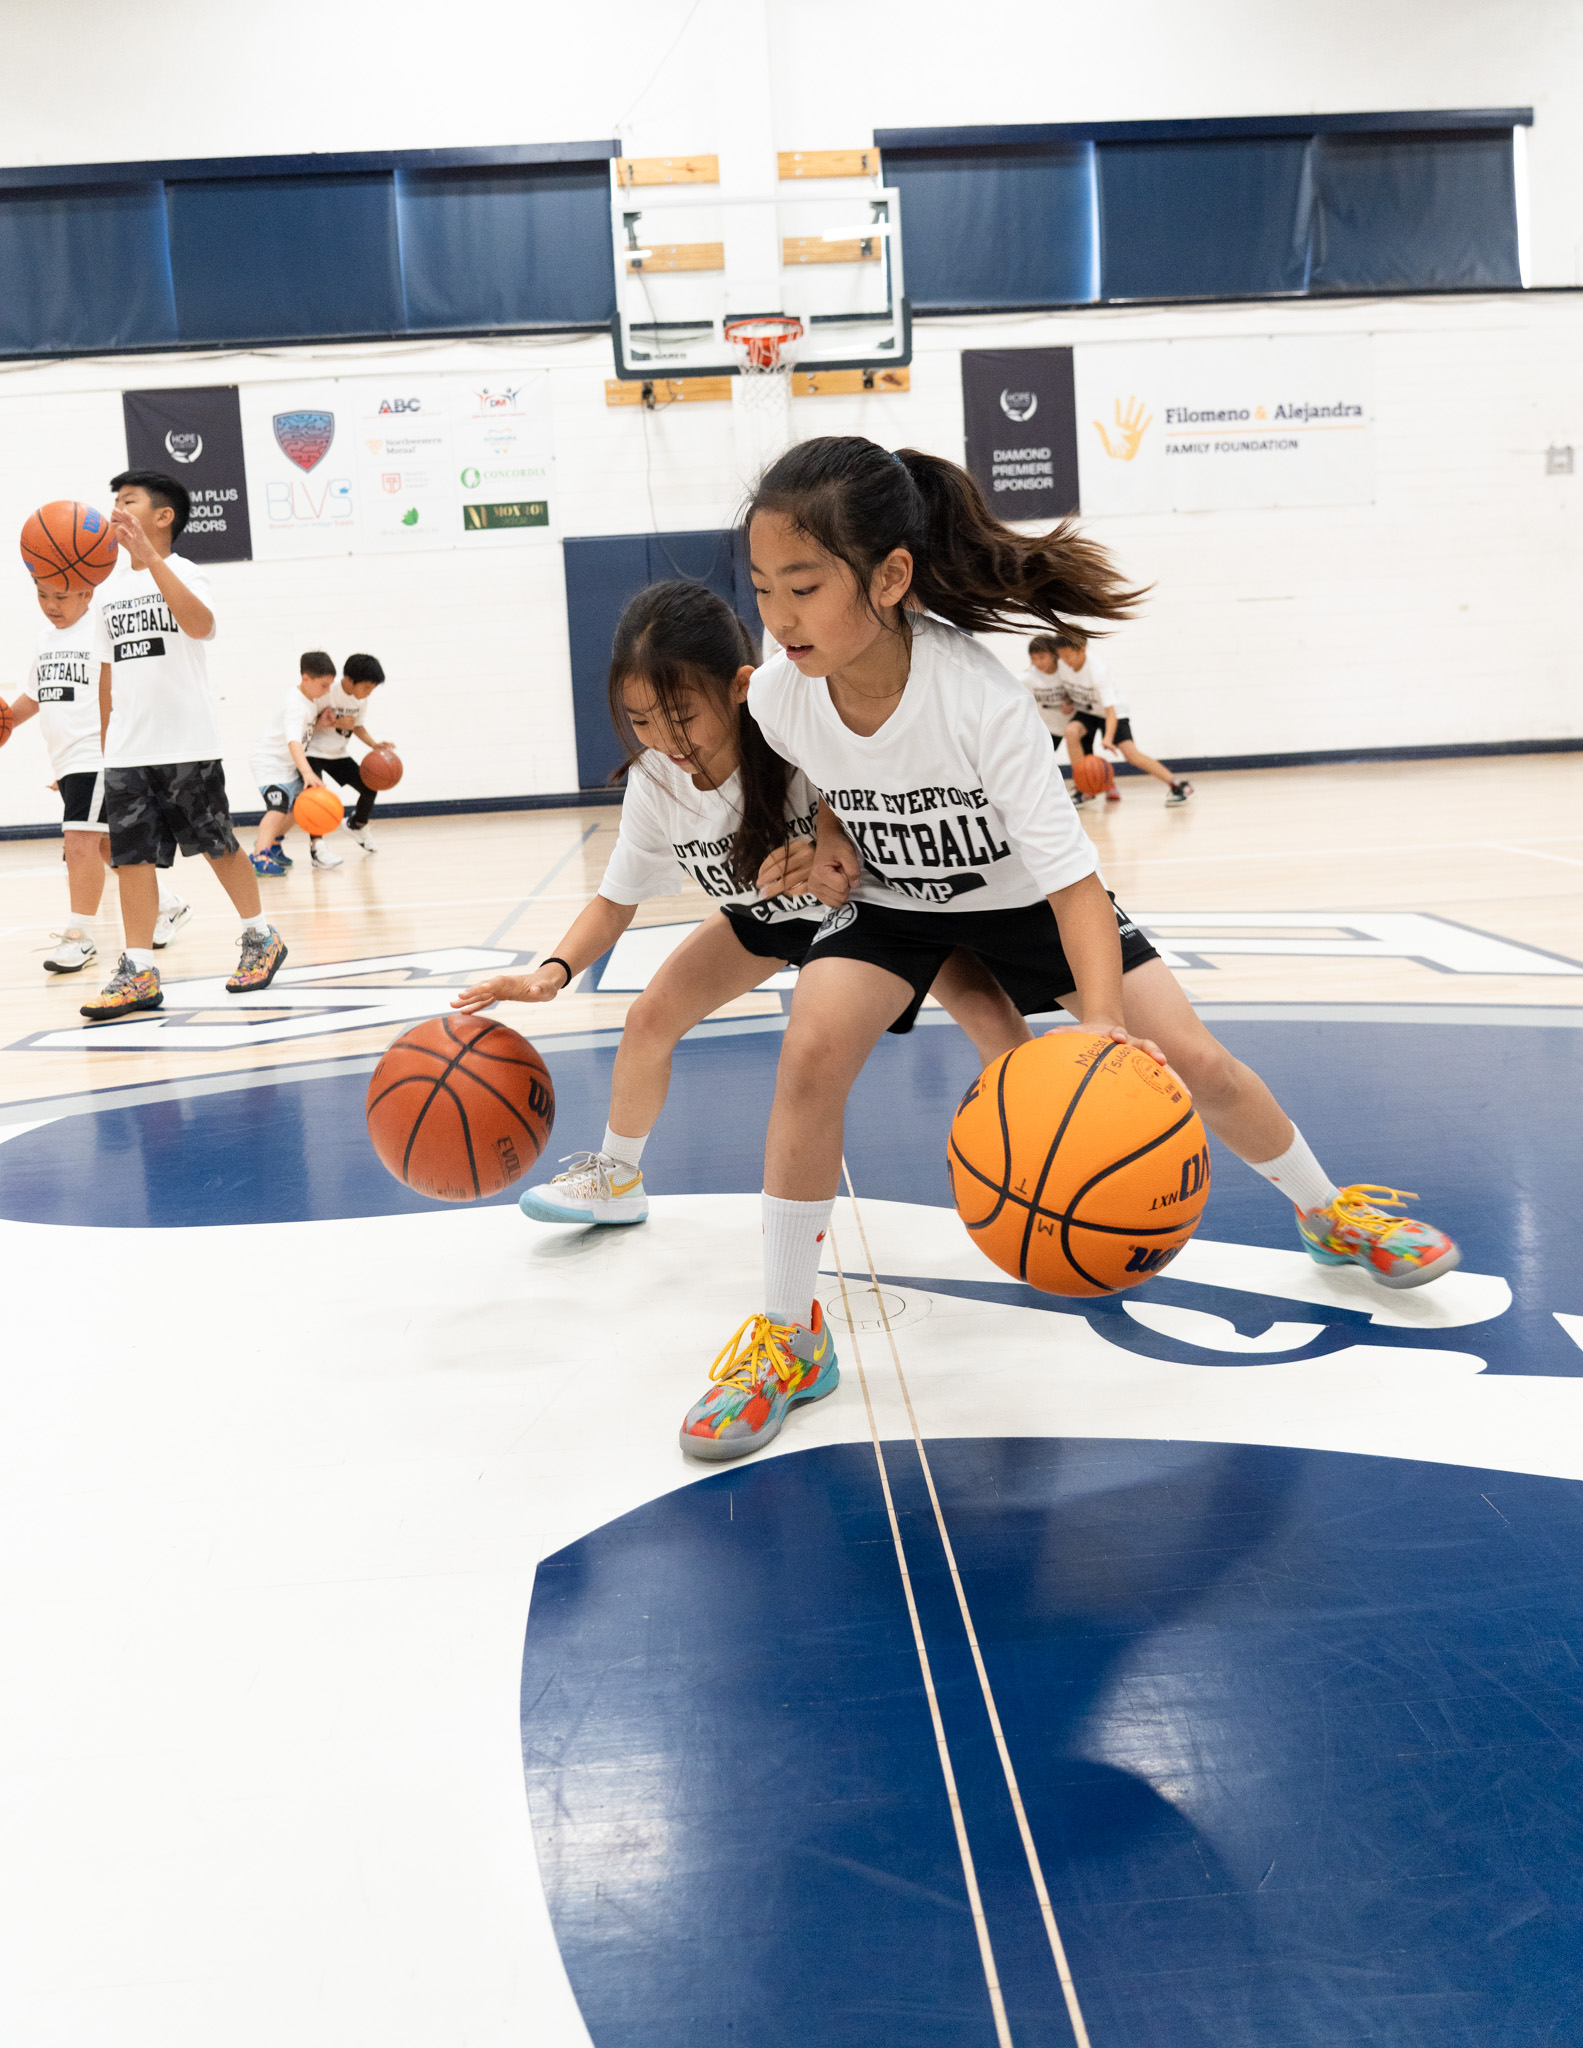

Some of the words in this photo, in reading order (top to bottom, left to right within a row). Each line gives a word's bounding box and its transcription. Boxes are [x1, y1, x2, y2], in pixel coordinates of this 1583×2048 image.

[378, 398, 421, 414] ABC
[1165, 407, 1250, 424] Filomeno
[1254, 405, 1267, 420] &
[1274, 402, 1363, 423] Alejandra
[172, 433, 196, 443] HOPE
[993, 447, 1052, 462] DIAMOND
[1165, 443, 1210, 455] FAMILY
[1214, 439, 1299, 453] FOUNDATION
[483, 467, 546, 480] CONCORDIA
[992, 462, 1054, 476] PREMIERE
[993, 477, 1054, 491] SPONSOR
[205, 488, 238, 501] PLUS
[266, 478, 354, 521] BLVS
[183, 520, 227, 533] NSORS
[105, 607, 179, 640] ASKETBALL
[54, 650, 90, 660] EVERYONE
[120, 640, 151, 659] CAMP
[40, 688, 63, 701] CAMP
[818, 788, 879, 812] WORK
[881, 786, 990, 815] EVERYONE
[847, 815, 1012, 867] KETBALL
[751, 892, 818, 922] CAMP
[1179, 1143, 1211, 1202] VO
[1148, 1190, 1179, 1212] NXT
